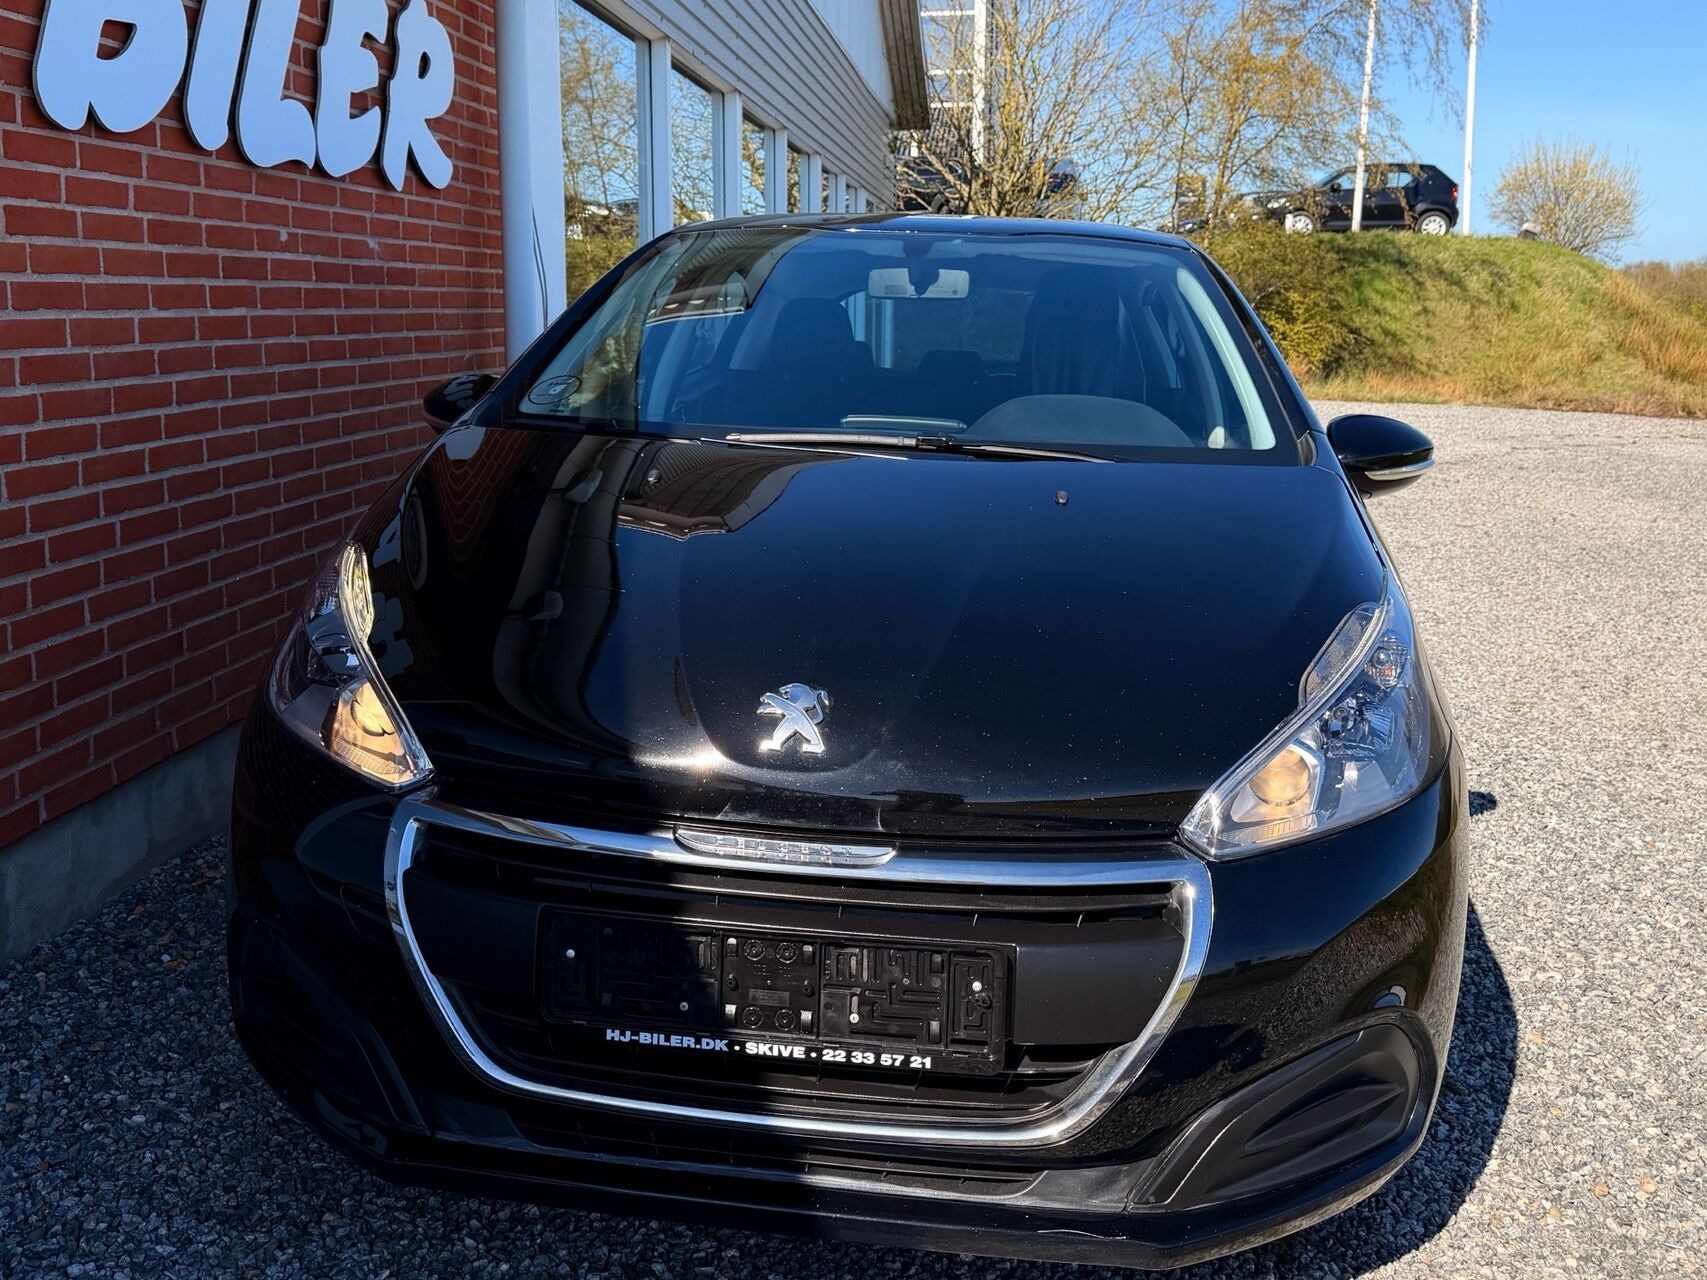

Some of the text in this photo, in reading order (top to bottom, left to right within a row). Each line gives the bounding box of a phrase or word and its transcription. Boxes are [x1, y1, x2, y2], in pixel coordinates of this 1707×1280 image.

[606, 1029, 932, 1069] HJ-BILER.DK SKIVE 22 33 57 21
